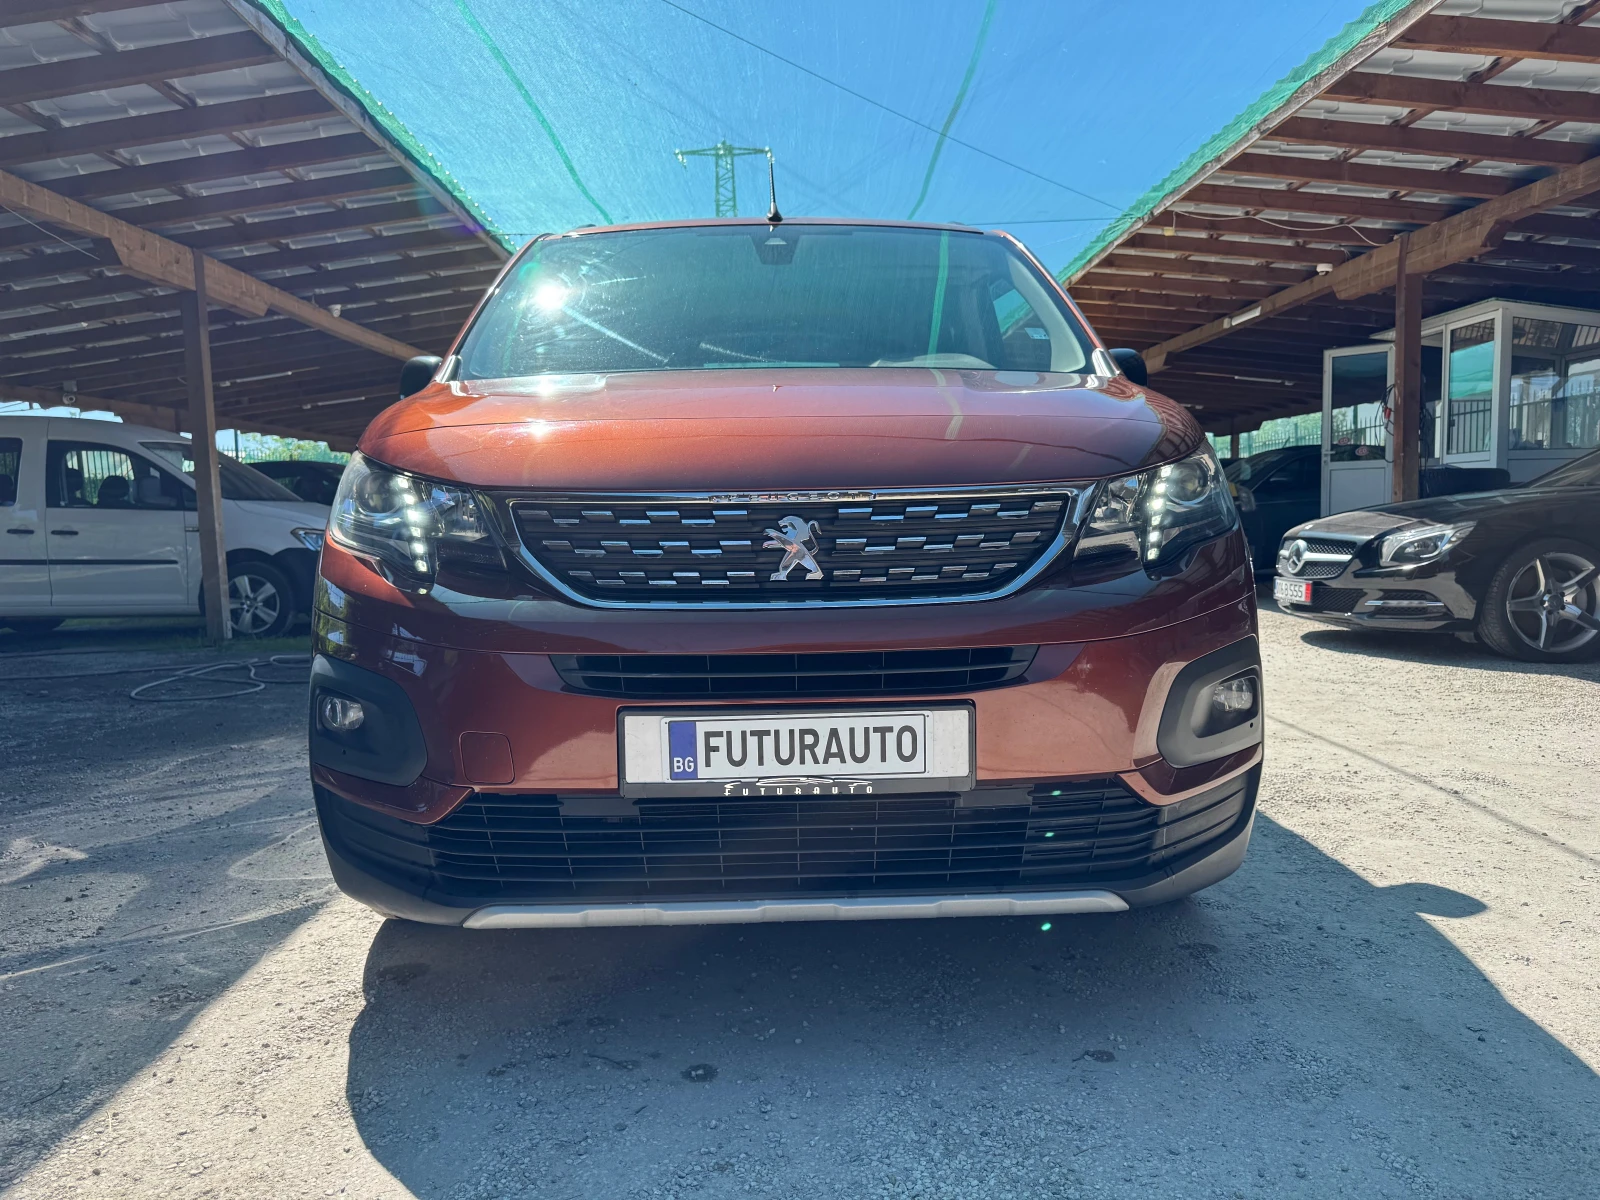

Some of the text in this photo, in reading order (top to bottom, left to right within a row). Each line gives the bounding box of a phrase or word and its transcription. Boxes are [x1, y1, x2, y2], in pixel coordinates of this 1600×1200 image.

[726, 491, 861, 502] PEUGEOT
[703, 725, 919, 768] FUTURAUTO
[673, 757, 695, 773] BG
[723, 785, 874, 797] FUTURAUTO
